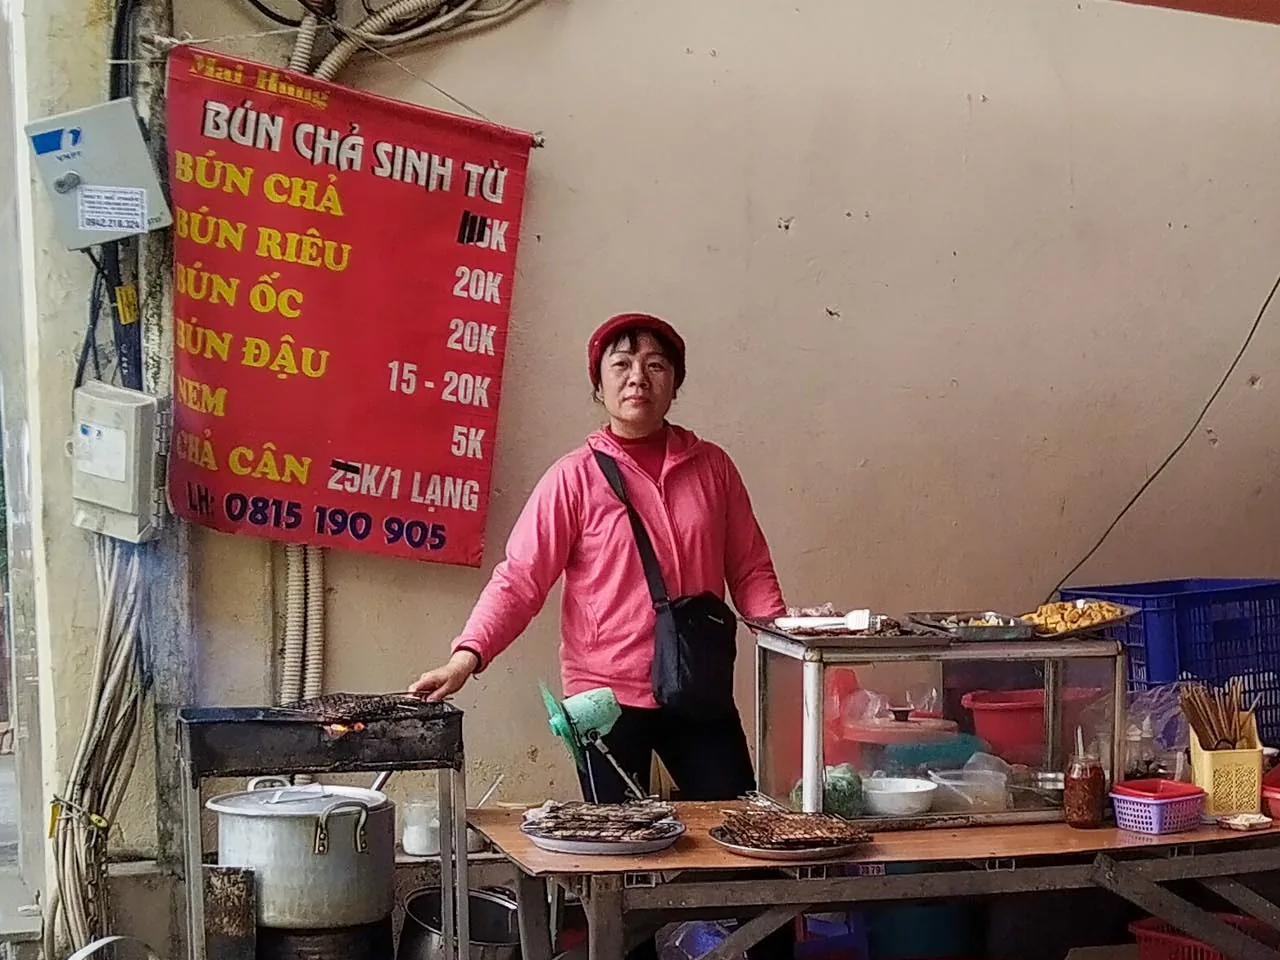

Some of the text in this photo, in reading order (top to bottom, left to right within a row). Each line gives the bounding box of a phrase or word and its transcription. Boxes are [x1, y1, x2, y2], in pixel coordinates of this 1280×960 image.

[203, 100, 284, 152] BÚN
[294, 123, 364, 173] CHẢ
[373, 141, 453, 192] SINH
[175, 150, 344, 216] BÚN CHẢ
[175, 206, 352, 271] BÚN RIÊU
[176, 261, 240, 307] BÚN
[250, 272, 304, 318] ỐC
[453, 265, 504, 304] 20K
[176, 317, 330, 379] BÚN ĐẬU
[446, 318, 497, 356] 20K
[177, 376, 228, 417] NEM
[388, 360, 417, 394] 15
[441, 371, 491, 408] 20K
[176, 428, 218, 471] CHẢ
[228, 441, 312, 485] CÂN
[410, 471, 480, 512] LẠNG
[451, 425, 486, 459] 5K
[223, 492, 302, 530] 0815
[313, 505, 373, 541] 190
[382, 516, 448, 551] 905
